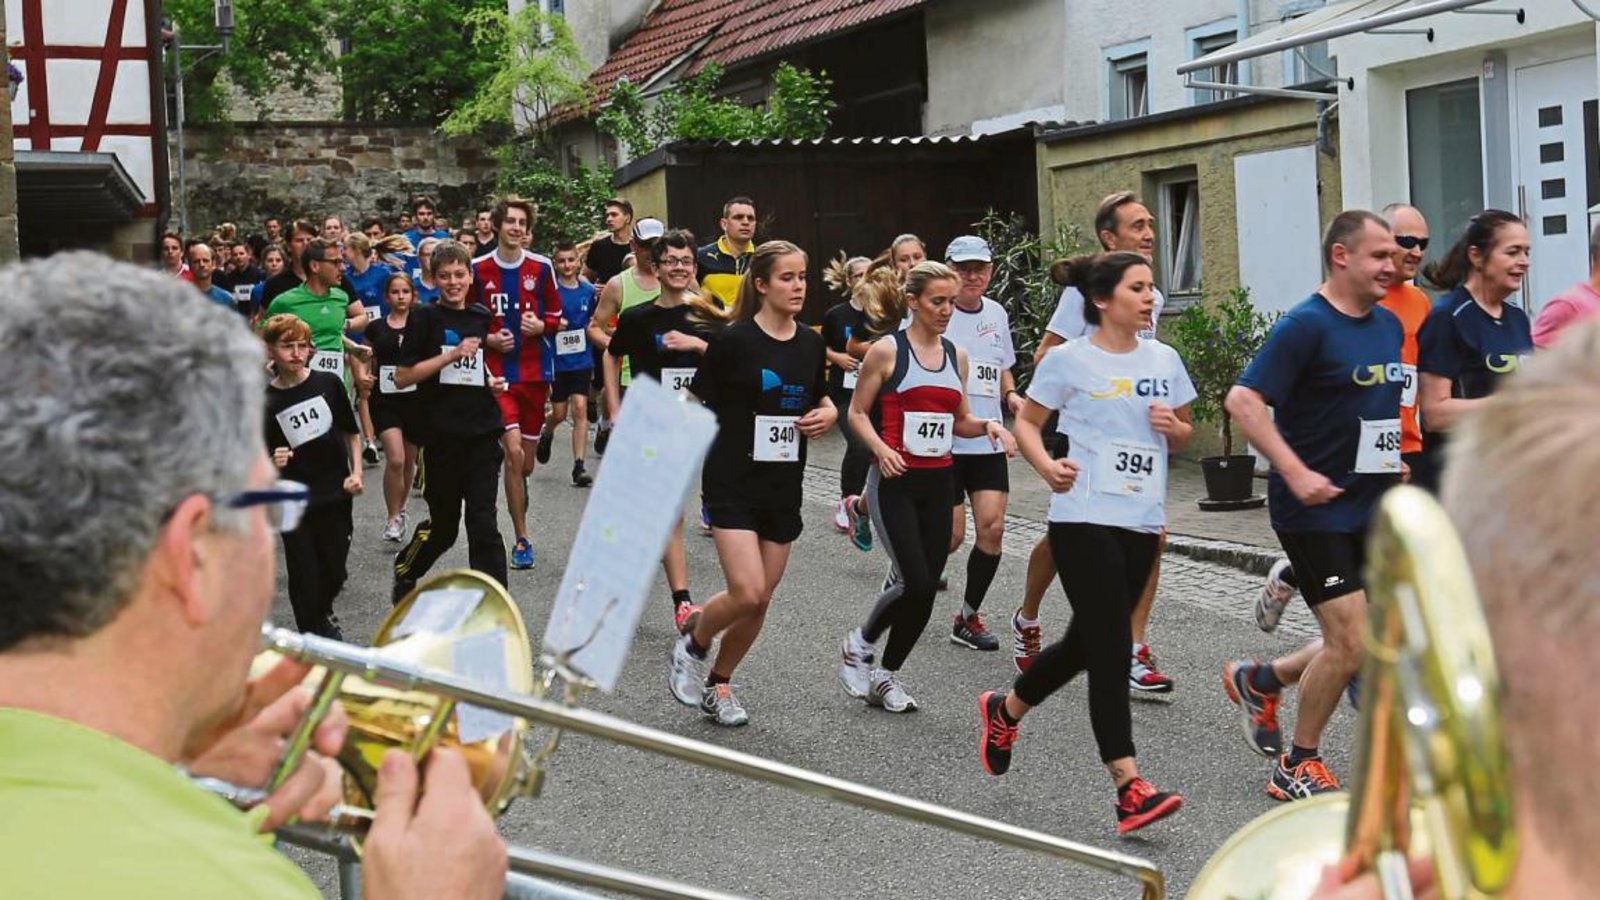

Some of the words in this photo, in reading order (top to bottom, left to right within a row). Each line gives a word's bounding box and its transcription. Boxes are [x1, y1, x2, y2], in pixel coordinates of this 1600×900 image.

[318, 358, 338, 369] 493
[977, 365, 997, 382] 304
[673, 376, 694, 390] 34
[1136, 378, 1168, 397] GLS
[290, 408, 319, 429] 314
[769, 426, 794, 443] 340
[917, 422, 945, 439] 474
[1115, 451, 1153, 475] 394
